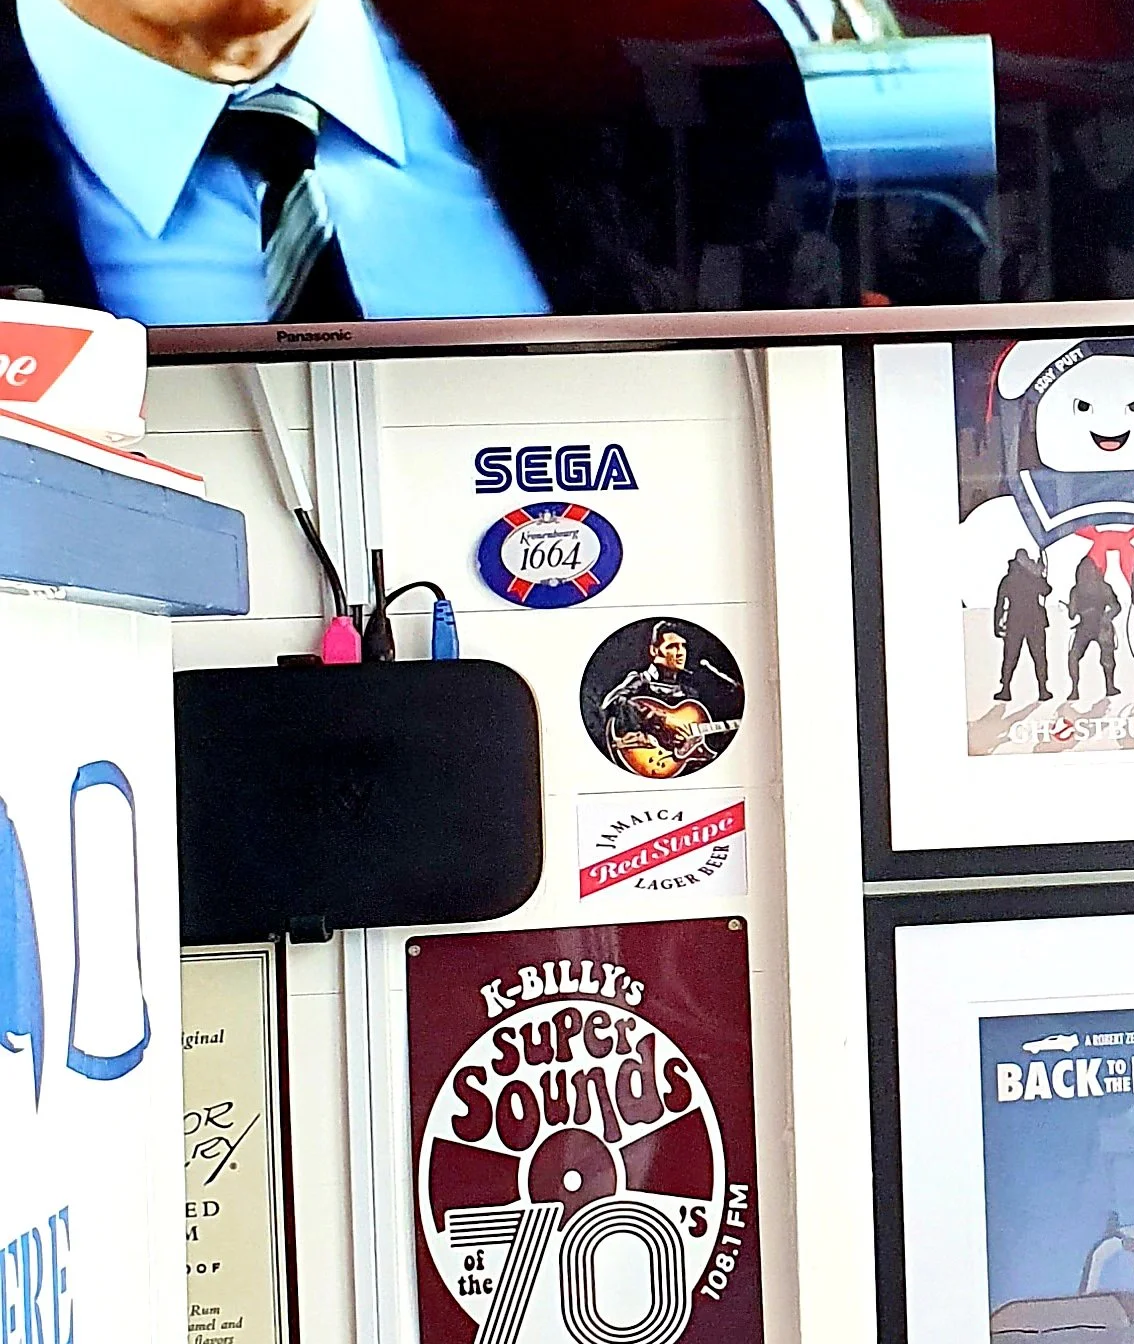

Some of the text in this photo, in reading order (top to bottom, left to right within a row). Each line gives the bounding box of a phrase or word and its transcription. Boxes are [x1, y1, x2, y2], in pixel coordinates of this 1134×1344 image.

[276, 328, 352, 345] Panasonic
[1033, 347, 1085, 395] STAY PUFT
[474, 444, 639, 494] SEGA
[520, 542, 581, 571] 1664
[595, 809, 684, 850] JAMAICA
[589, 816, 735, 884] Red Stripe
[633, 843, 730, 892] LAGER BEER
[480, 960, 644, 1018] K-BILLY'S
[1084, 1035, 1091, 1047] A
[1093, 1033, 1123, 1046] ROBERT
[997, 1057, 1104, 1102] BACK
[1104, 1076, 1131, 1093] THE
[1106, 1059, 1126, 1075] TO
[451, 1032, 693, 1152] Sounds
[700, 1183, 749, 1301] 108.1 FM
[463, 1248, 485, 1272] of
[458, 1274, 493, 1297] the
[190, 1304, 220, 1317] Rum
[221, 1316, 243, 1330] and
